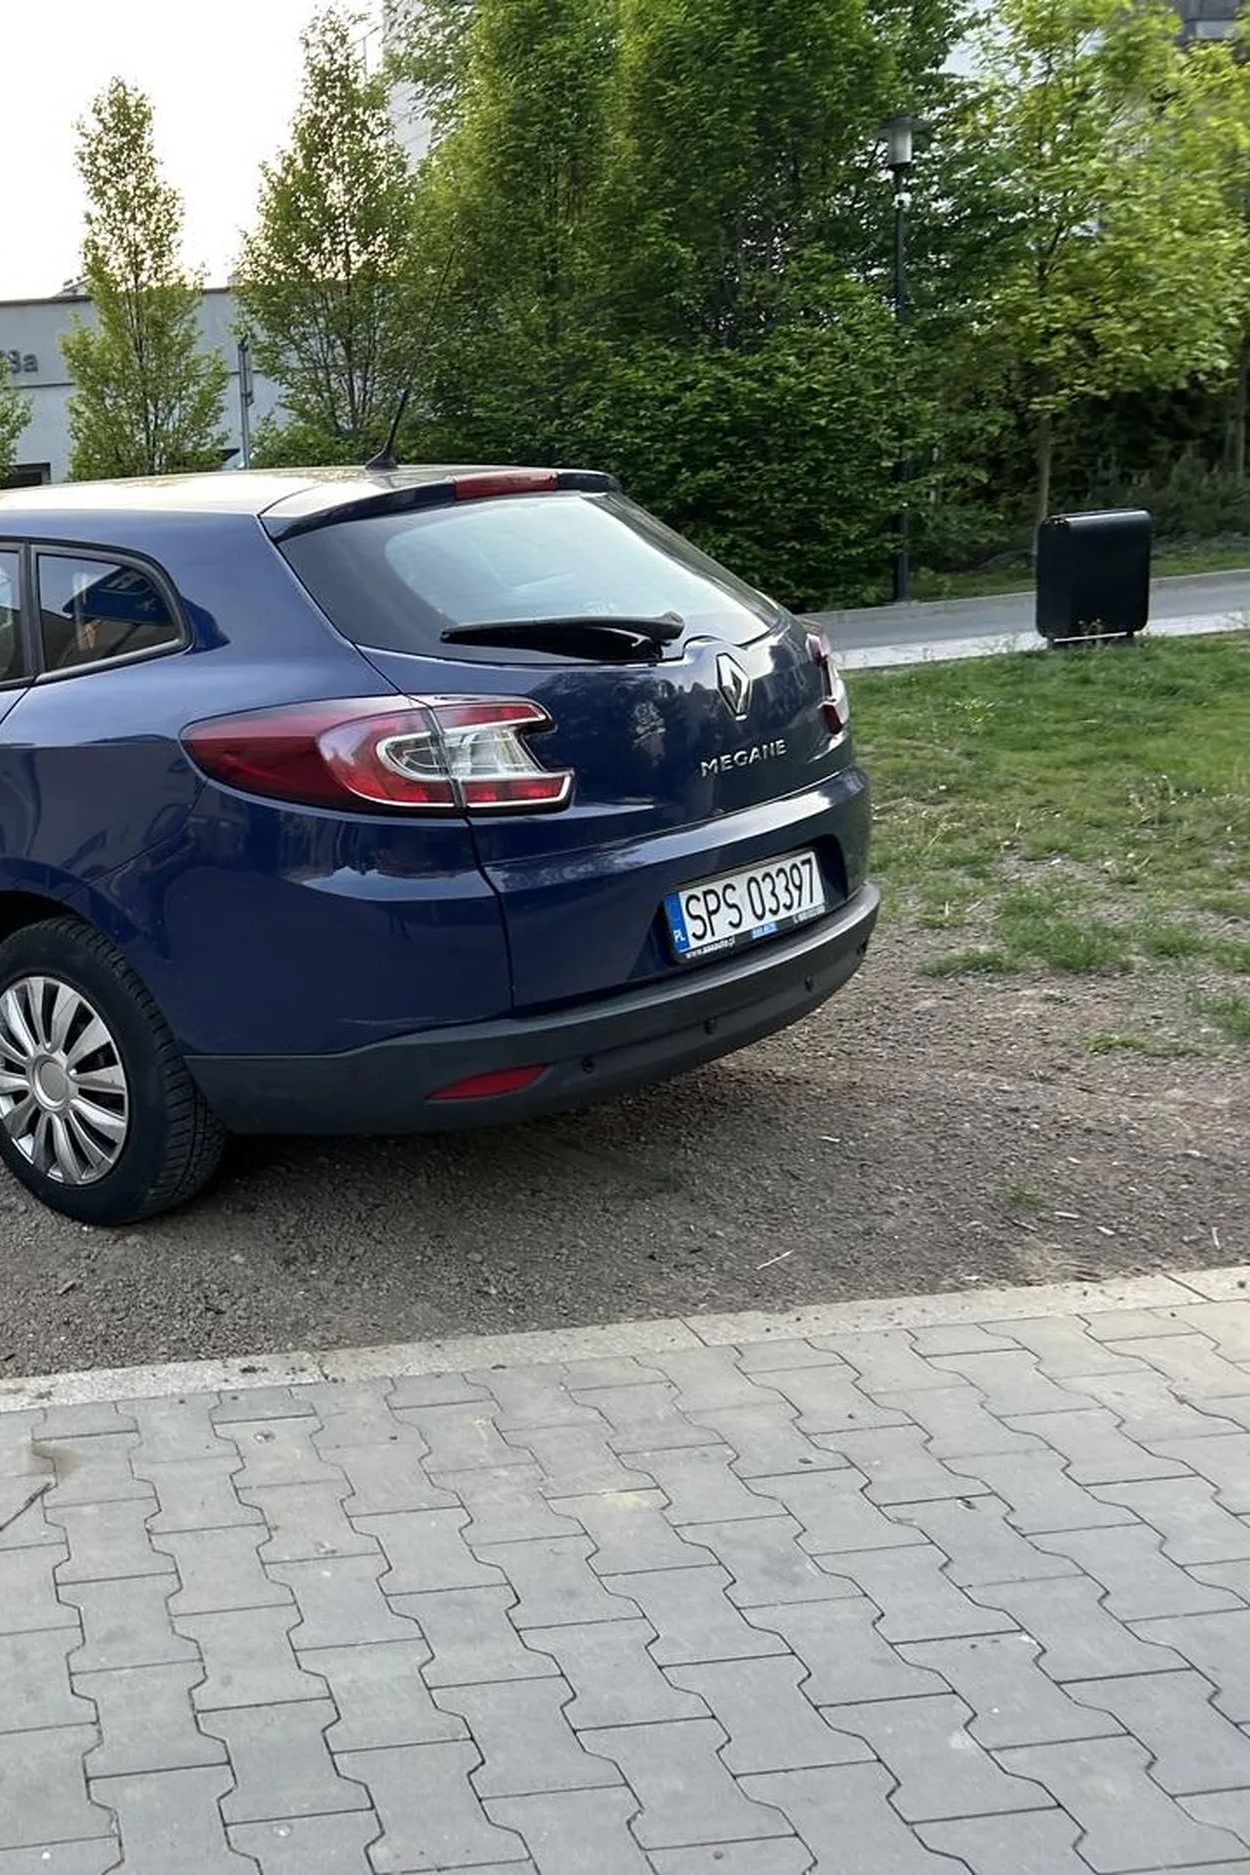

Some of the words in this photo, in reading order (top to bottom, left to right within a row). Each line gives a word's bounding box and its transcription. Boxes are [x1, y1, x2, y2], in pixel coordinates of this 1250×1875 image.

[700, 739, 788, 777] MEGANE
[685, 883, 743, 940] SPS
[747, 857, 814, 921] 03397
[673, 929, 686, 943] PL
